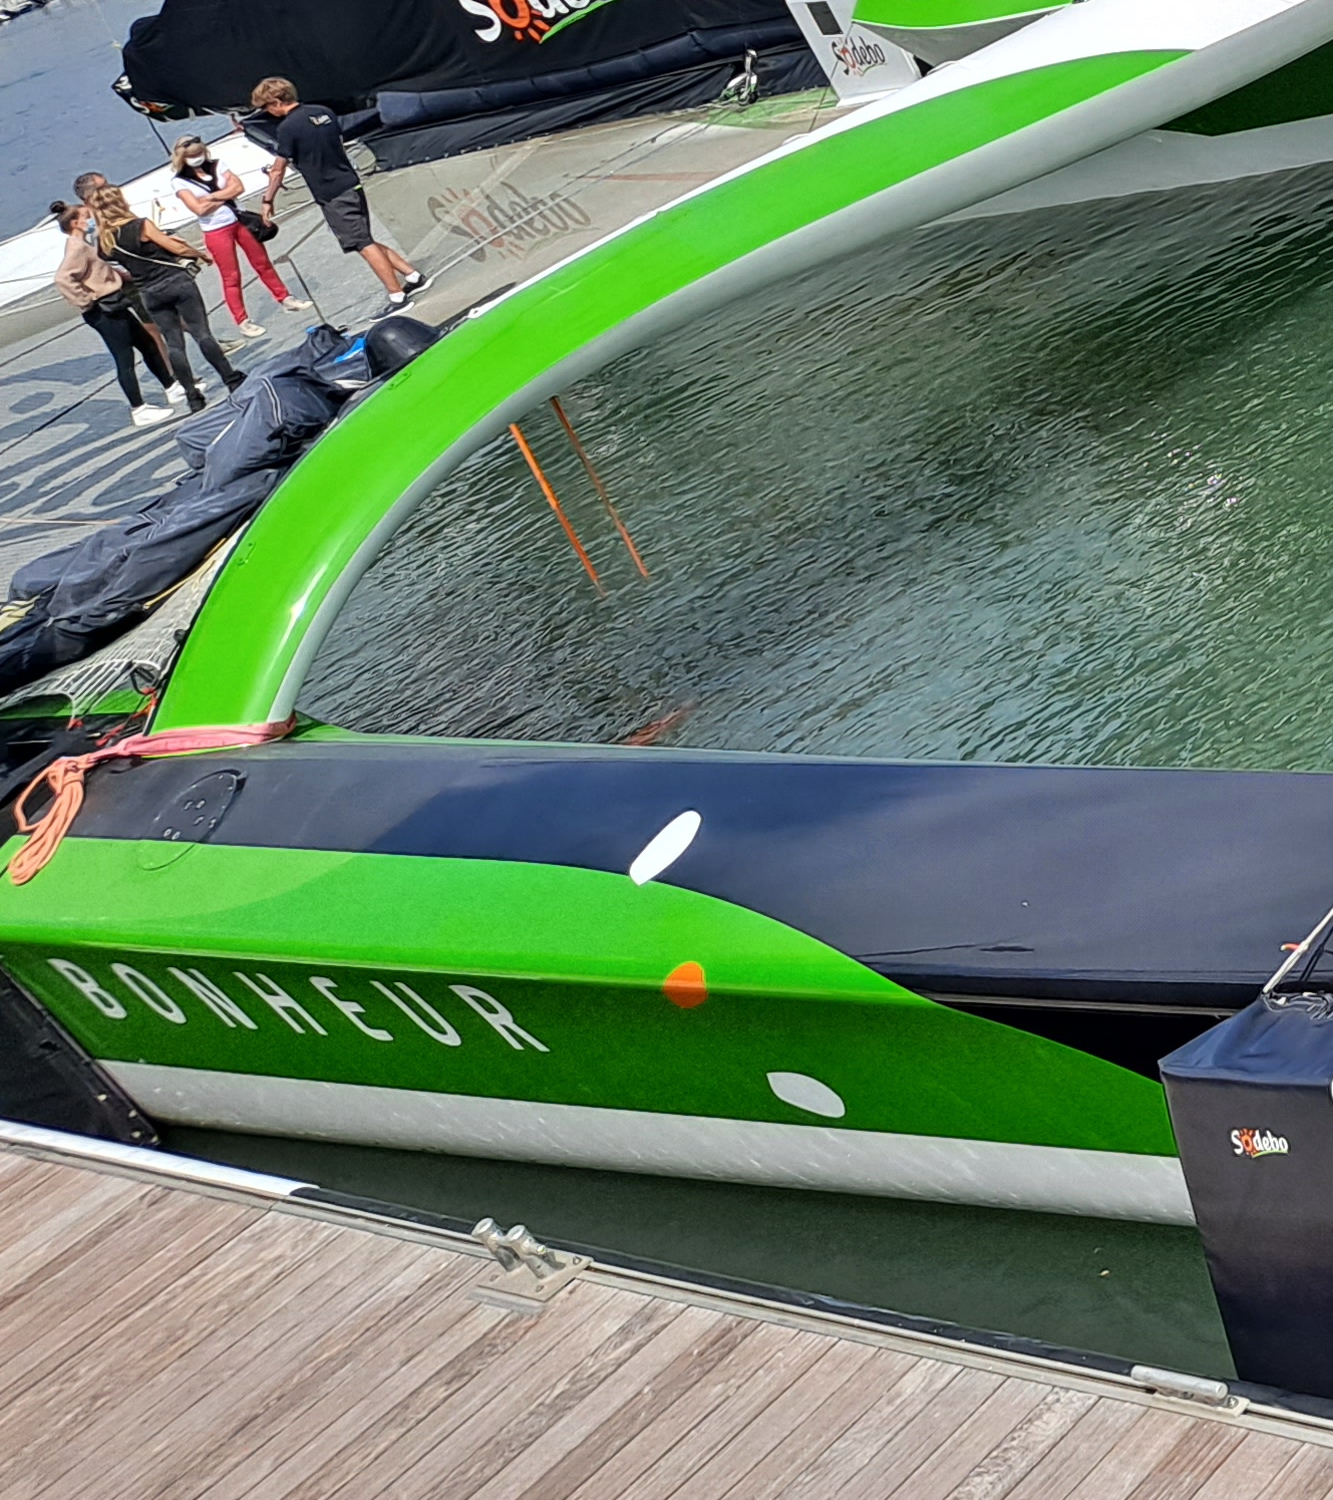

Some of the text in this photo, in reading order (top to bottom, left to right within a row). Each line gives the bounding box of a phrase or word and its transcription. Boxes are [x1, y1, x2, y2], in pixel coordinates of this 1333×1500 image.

[831, 35, 887, 76] Sodebo
[46, 957, 551, 1053] BONHEUR
[1230, 1127, 1289, 1156] Sodebo
